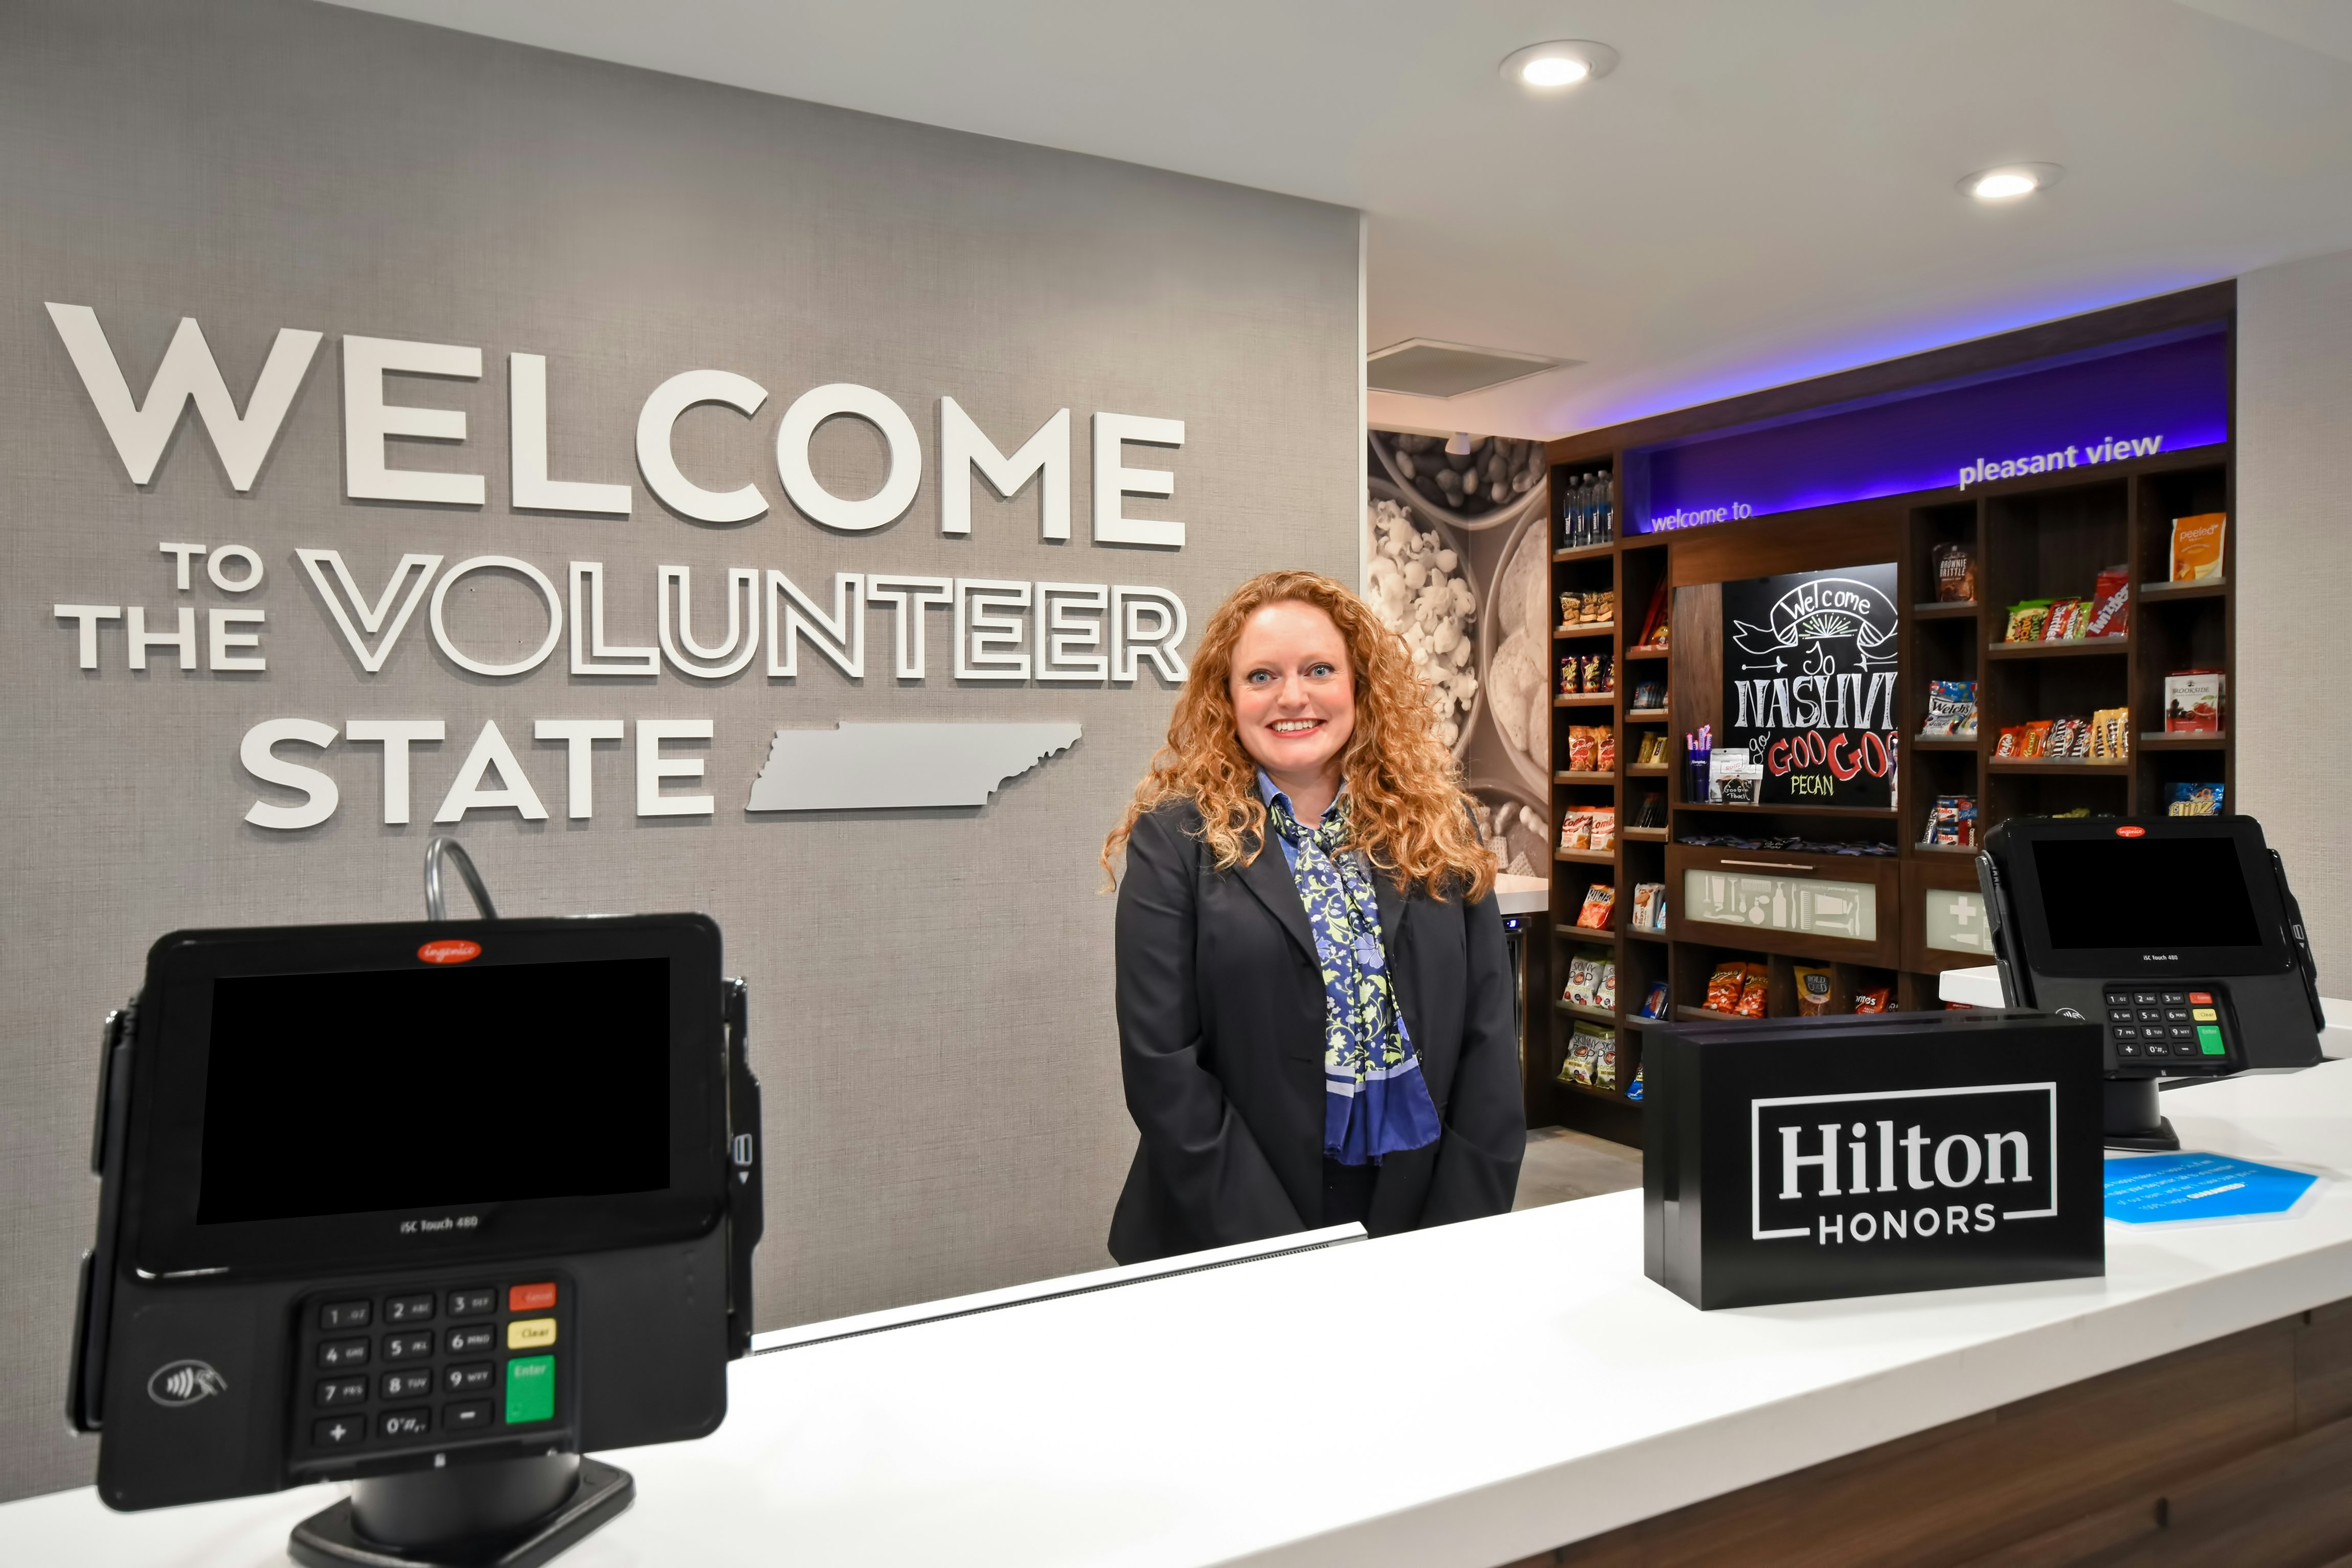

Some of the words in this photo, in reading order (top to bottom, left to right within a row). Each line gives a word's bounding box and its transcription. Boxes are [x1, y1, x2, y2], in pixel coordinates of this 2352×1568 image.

[44, 302, 1185, 546] WELCOME
[1959, 445, 2078, 491] pleasant
[2086, 435, 2163, 464] view
[1652, 507, 1727, 532] welcome
[1732, 502, 1751, 519] to
[159, 542, 264, 592] TO
[1940, 559, 1967, 569] BROWNIE
[1940, 567, 1965, 577] BRITTLE
[295, 548, 1188, 681] VOLUNTEER
[1780, 582, 1870, 620] Welcome
[54, 604, 265, 670] THE
[1803, 641, 1835, 675] To
[1749, 731, 1770, 765] go
[1768, 730, 1826, 777] GOO
[240, 717, 714, 829] STATE
[1791, 775, 1834, 796] PECAN
[2119, 828, 2142, 836] ingenico
[1574, 1035, 1599, 1049] SKINNY
[1778, 1120, 2032, 1199] Hilton
[421, 1217, 454, 1232] Touch
[457, 1216, 478, 1228] 480
[1819, 1203, 1996, 1245] HONORS
[331, 1309, 338, 1324] 1
[394, 1303, 404, 1319] 2
[455, 1297, 465, 1312] 3
[326, 1348, 338, 1363] 4
[391, 1340, 402, 1356] 5
[451, 1334, 464, 1350] 6
[522, 1328, 550, 1339] Clear
[325, 1385, 336, 1402] 7
[389, 1378, 401, 1394] 8
[450, 1371, 462, 1388] 9
[514, 1365, 547, 1378] Enter
